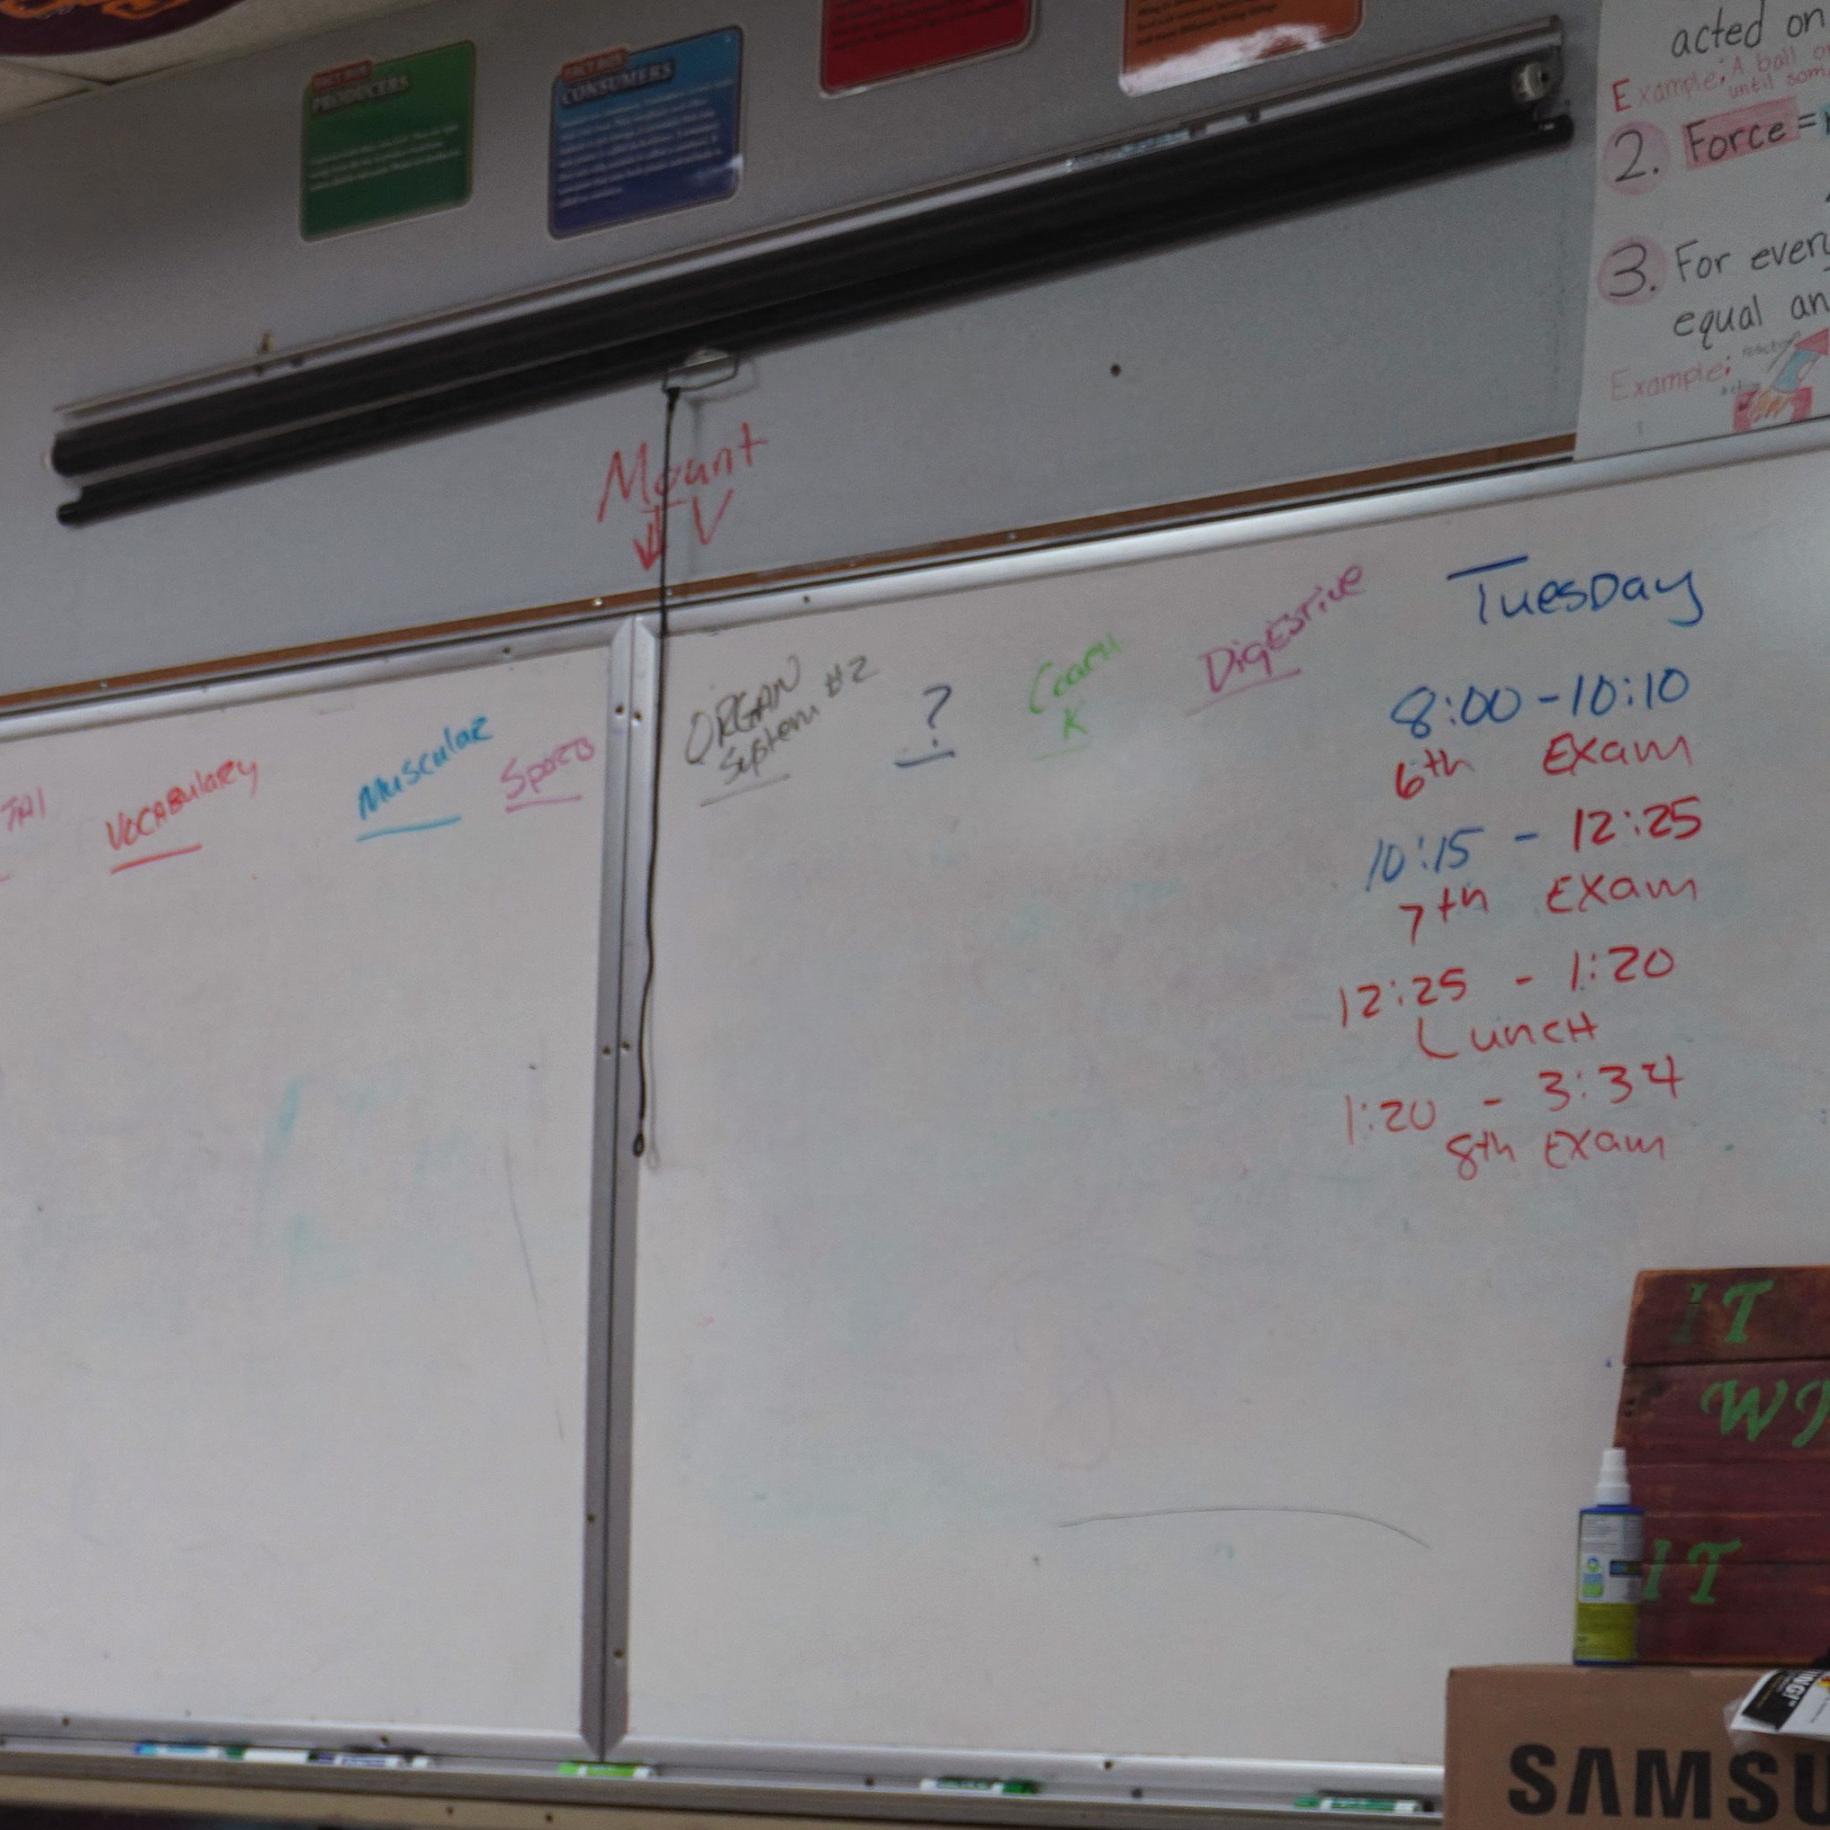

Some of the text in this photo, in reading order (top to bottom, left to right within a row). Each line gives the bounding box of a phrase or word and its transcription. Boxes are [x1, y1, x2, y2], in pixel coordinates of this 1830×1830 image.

[1671, 0, 1764, 58] acted
[1756, 45, 1795, 72] ball
[562, 61, 673, 107] CONSUMERS
[1786, 65, 1830, 86] som
[1613, 129, 1660, 183] 2.
[1687, 117, 1787, 163] Force
[1608, 243, 1658, 299] 3.
[1674, 238, 1731, 283] For
[1672, 289, 1830, 351] equal an
[596, 421, 769, 523] Mount
[924, 685, 953, 747] ?
[1390, 684, 1522, 739] 8:00
[1569, 667, 1691, 720] 10:10
[1395, 748, 1474, 799] 6th
[1365, 825, 1485, 892] 10:15
[1574, 796, 1703, 852] 12:25
[1398, 885, 1489, 946] 7th
[1338, 967, 1467, 1028] 12:25
[1571, 946, 1676, 991] 1:20
[1343, 1094, 1438, 1146] 1:20
[1538, 1053, 1685, 1113] 3:34
[1446, 1130, 1517, 1181] 8th
[1669, 1279, 1775, 1346] IT
[1641, 1539, 1743, 1606] IT
[1508, 1743, 1830, 1827] SAMSU
